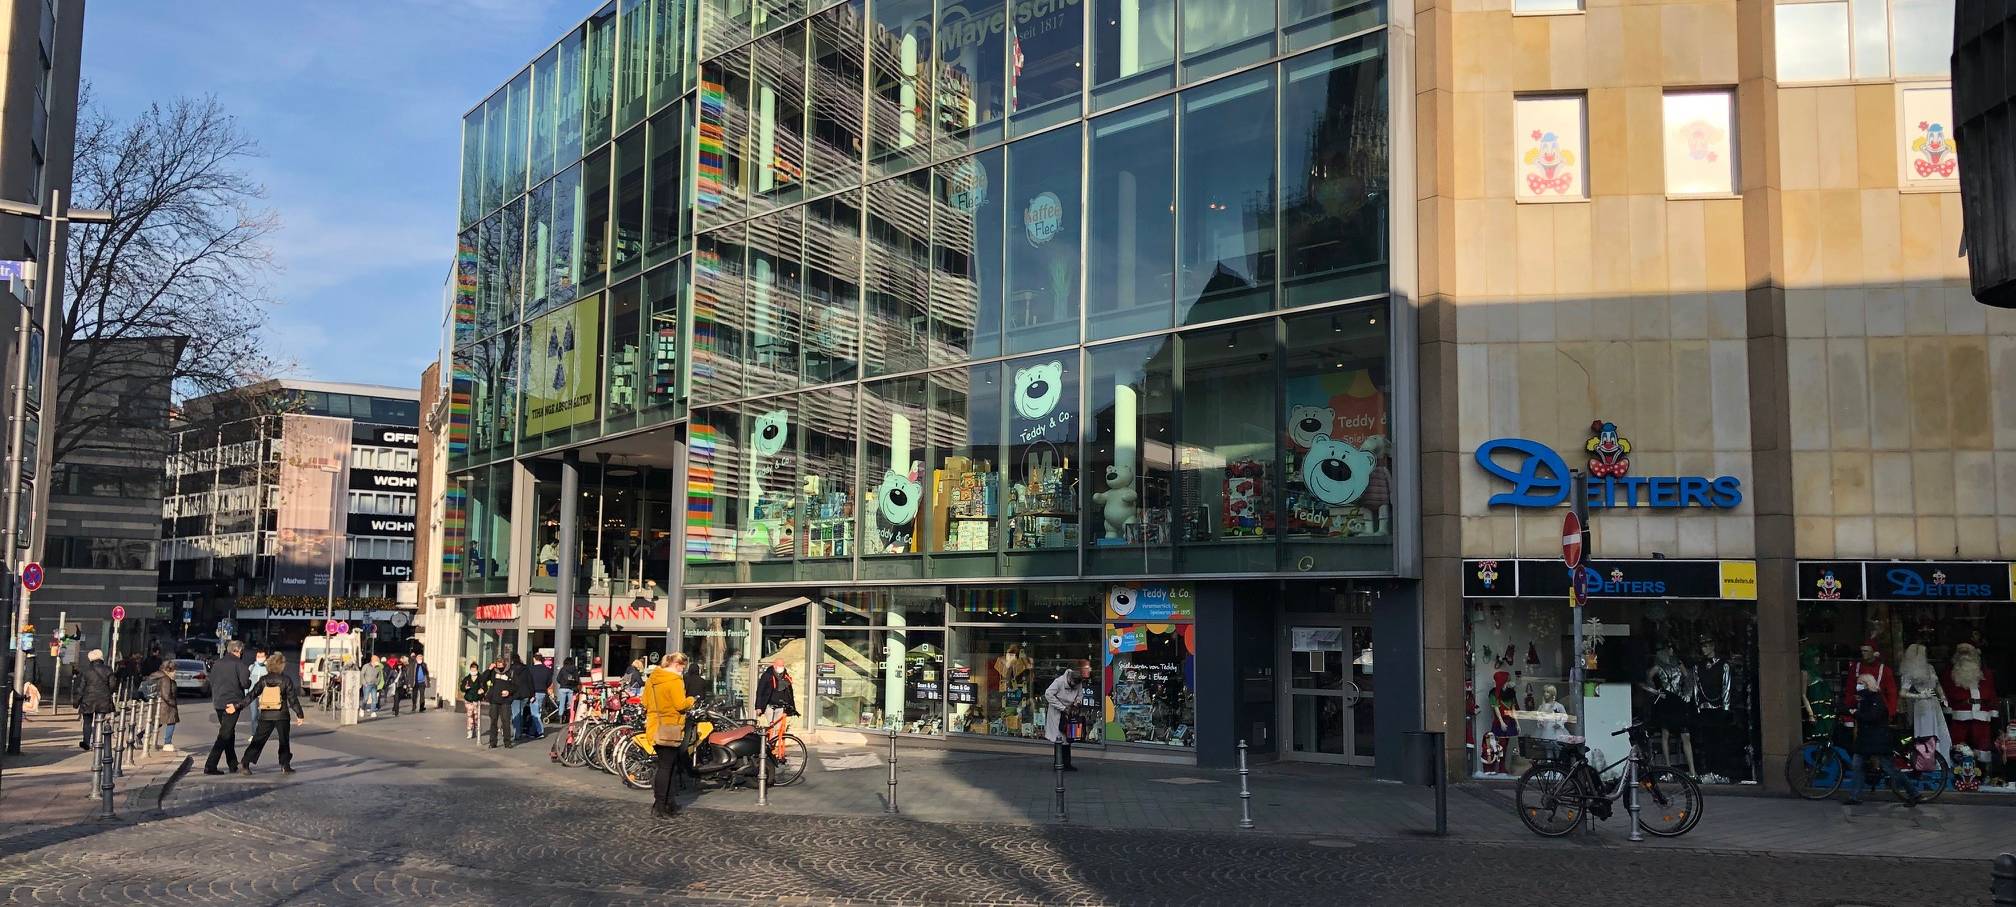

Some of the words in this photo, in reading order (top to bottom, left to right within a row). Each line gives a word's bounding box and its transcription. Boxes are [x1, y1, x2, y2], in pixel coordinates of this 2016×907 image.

[1024, 202, 1062, 224] Kaffee
[1020, 424, 1046, 443] Teddy
[1049, 417, 1056, 428] &
[1058, 411, 1073, 422] Co.
[1338, 414, 1375, 431] Teddy
[383, 432, 418, 443] OFFI
[373, 475, 417, 487] WOHN
[1474, 438, 1743, 508] DEITERS
[371, 520, 414, 531] WOHN
[1293, 507, 1329, 528] Teddy
[1333, 514, 1342, 528] &
[896, 531, 901, 540] &
[282, 577, 306, 585] Mathes
[1568, 567, 1666, 593] DEITERS
[1887, 568, 1992, 596] DEITERS
[1142, 588, 1167, 600] Teddy
[1169, 588, 1176, 598] &
[544, 603, 655, 620] RSSMANN
[1160, 662, 1177, 672] Teddy
